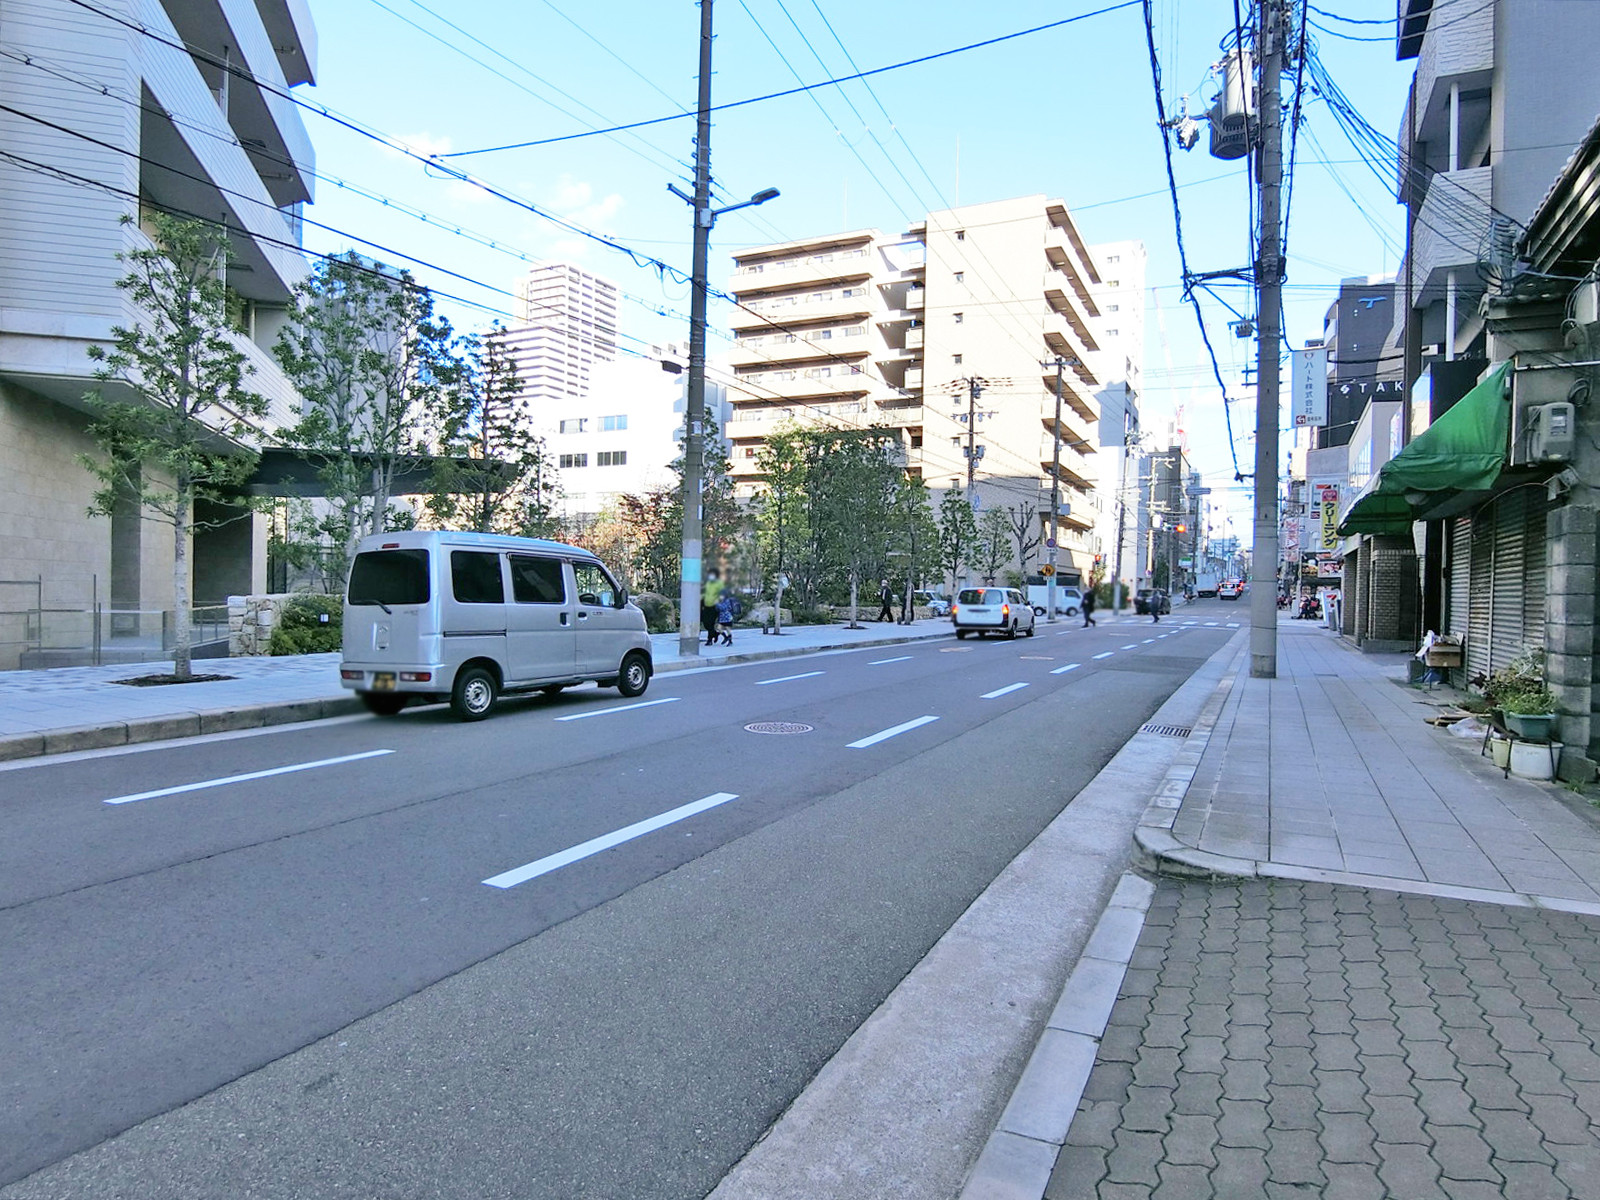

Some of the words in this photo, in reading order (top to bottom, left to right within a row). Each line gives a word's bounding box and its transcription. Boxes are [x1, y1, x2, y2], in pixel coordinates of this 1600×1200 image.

[1304, 361, 1314, 414] ハート株式会社
[1323, 501, 1336, 546] クリーニング
